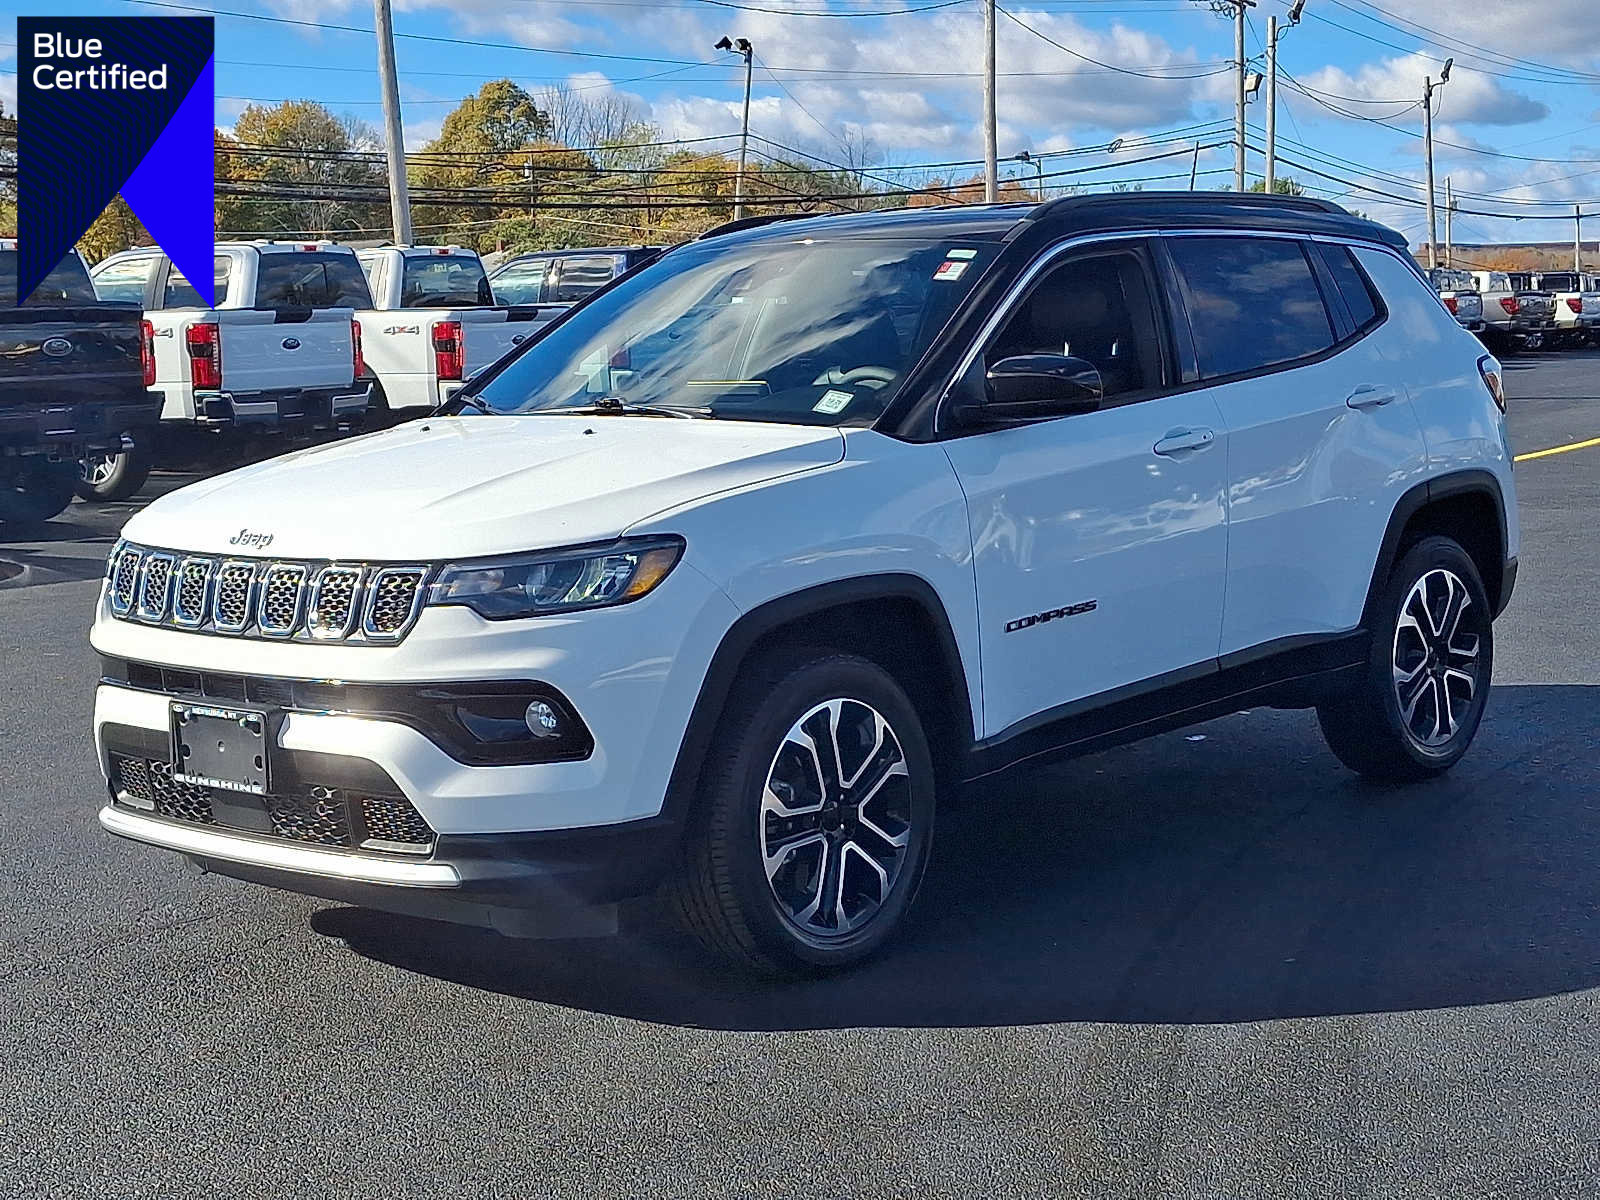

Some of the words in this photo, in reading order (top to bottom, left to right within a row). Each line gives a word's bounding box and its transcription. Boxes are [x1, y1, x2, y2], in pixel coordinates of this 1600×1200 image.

[229, 528, 274, 550] Jeep
[1004, 599, 1097, 633] COMPASS
[173, 773, 264, 796] SUNSHINE
